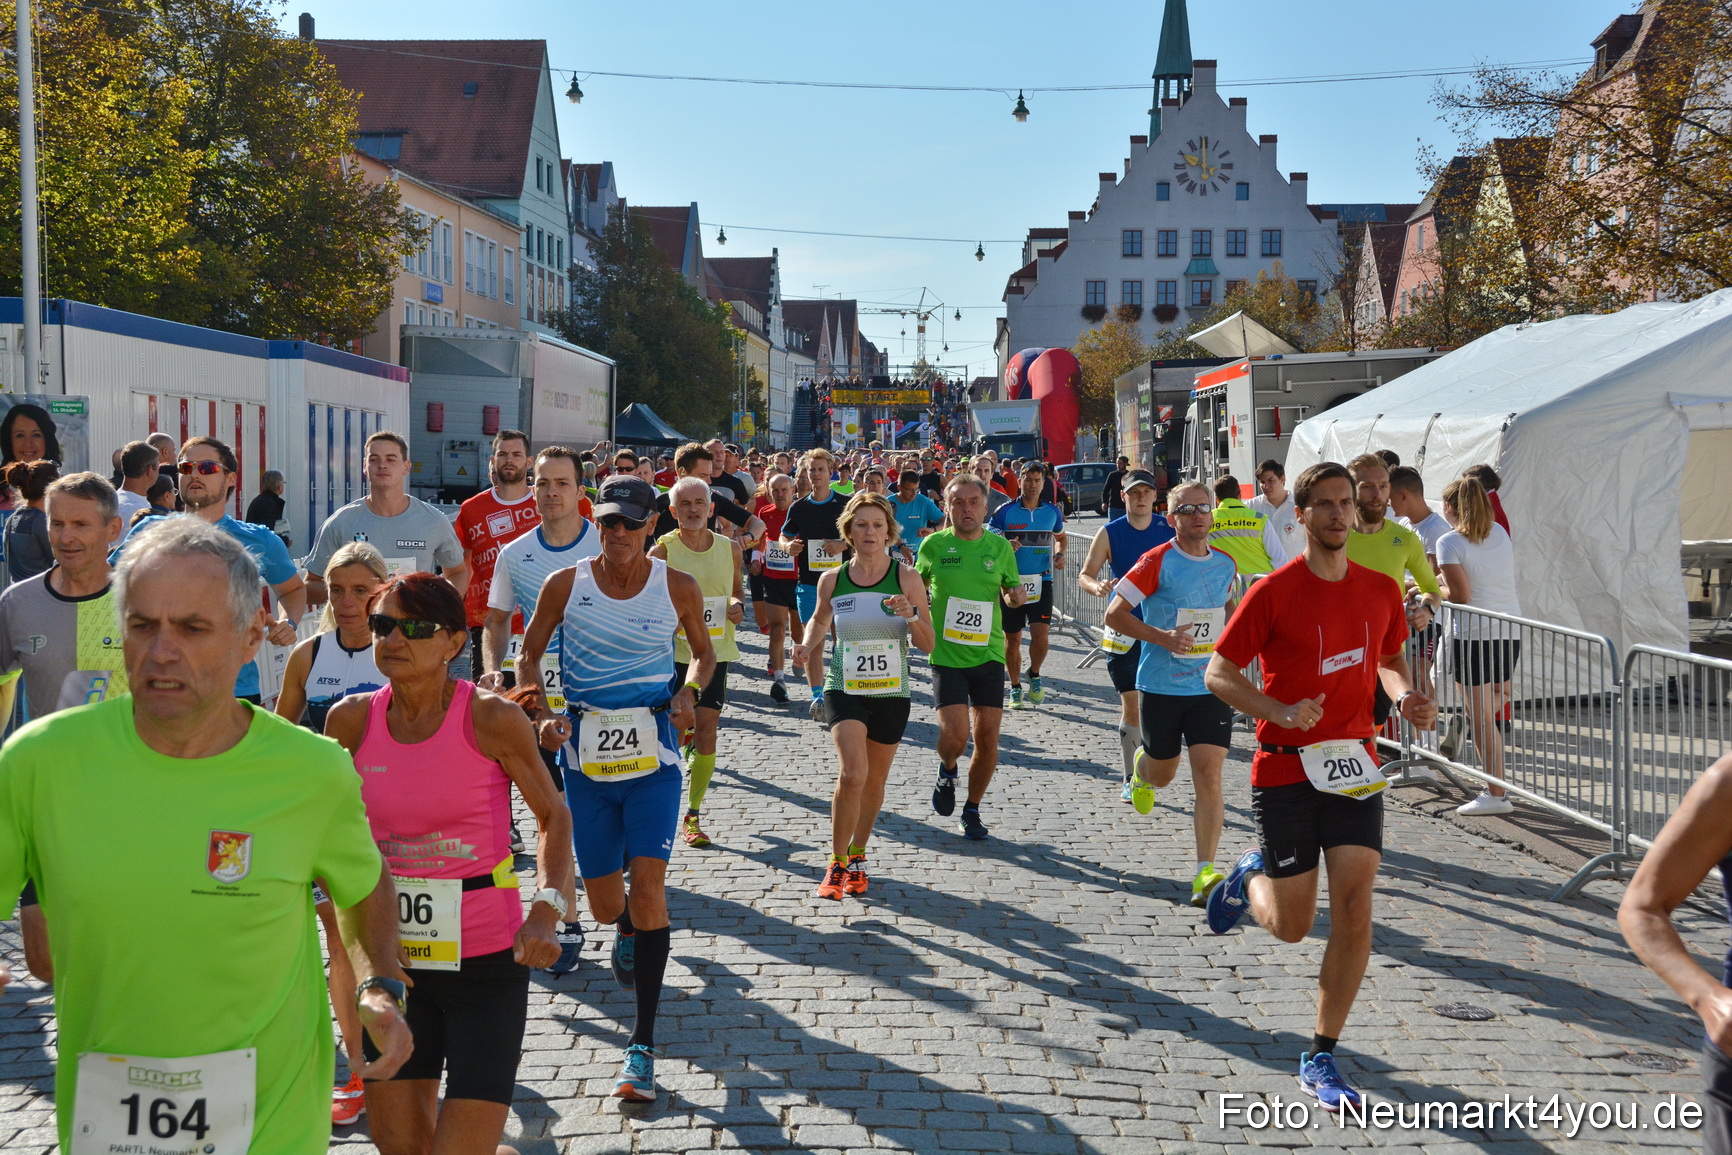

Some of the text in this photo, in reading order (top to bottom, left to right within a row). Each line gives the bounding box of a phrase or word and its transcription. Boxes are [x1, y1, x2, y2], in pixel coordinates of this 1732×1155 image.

[863, 392, 898, 401] START
[990, 416, 1022, 424] BOCK
[397, 540, 426, 548] BOCK
[955, 611, 982, 627] 228
[1193, 622, 1210, 638] 73
[856, 655, 888, 672] 215
[1333, 655, 1353, 667] DEHN
[316, 676, 341, 684] ATSV
[857, 680, 888, 688] Christine
[600, 714, 633, 724] BOCK
[597, 728, 639, 752] 224
[1323, 745, 1350, 755] BOCK
[601, 761, 639, 774] Hartmut
[1323, 757, 1363, 782] 260
[390, 831, 443, 843] BRAUEREI
[397, 892, 433, 925] 06
[128, 1066, 203, 1087] BOCK
[120, 1093, 211, 1141] 164
[109, 1143, 199, 1155] PARTL Neumarkt
